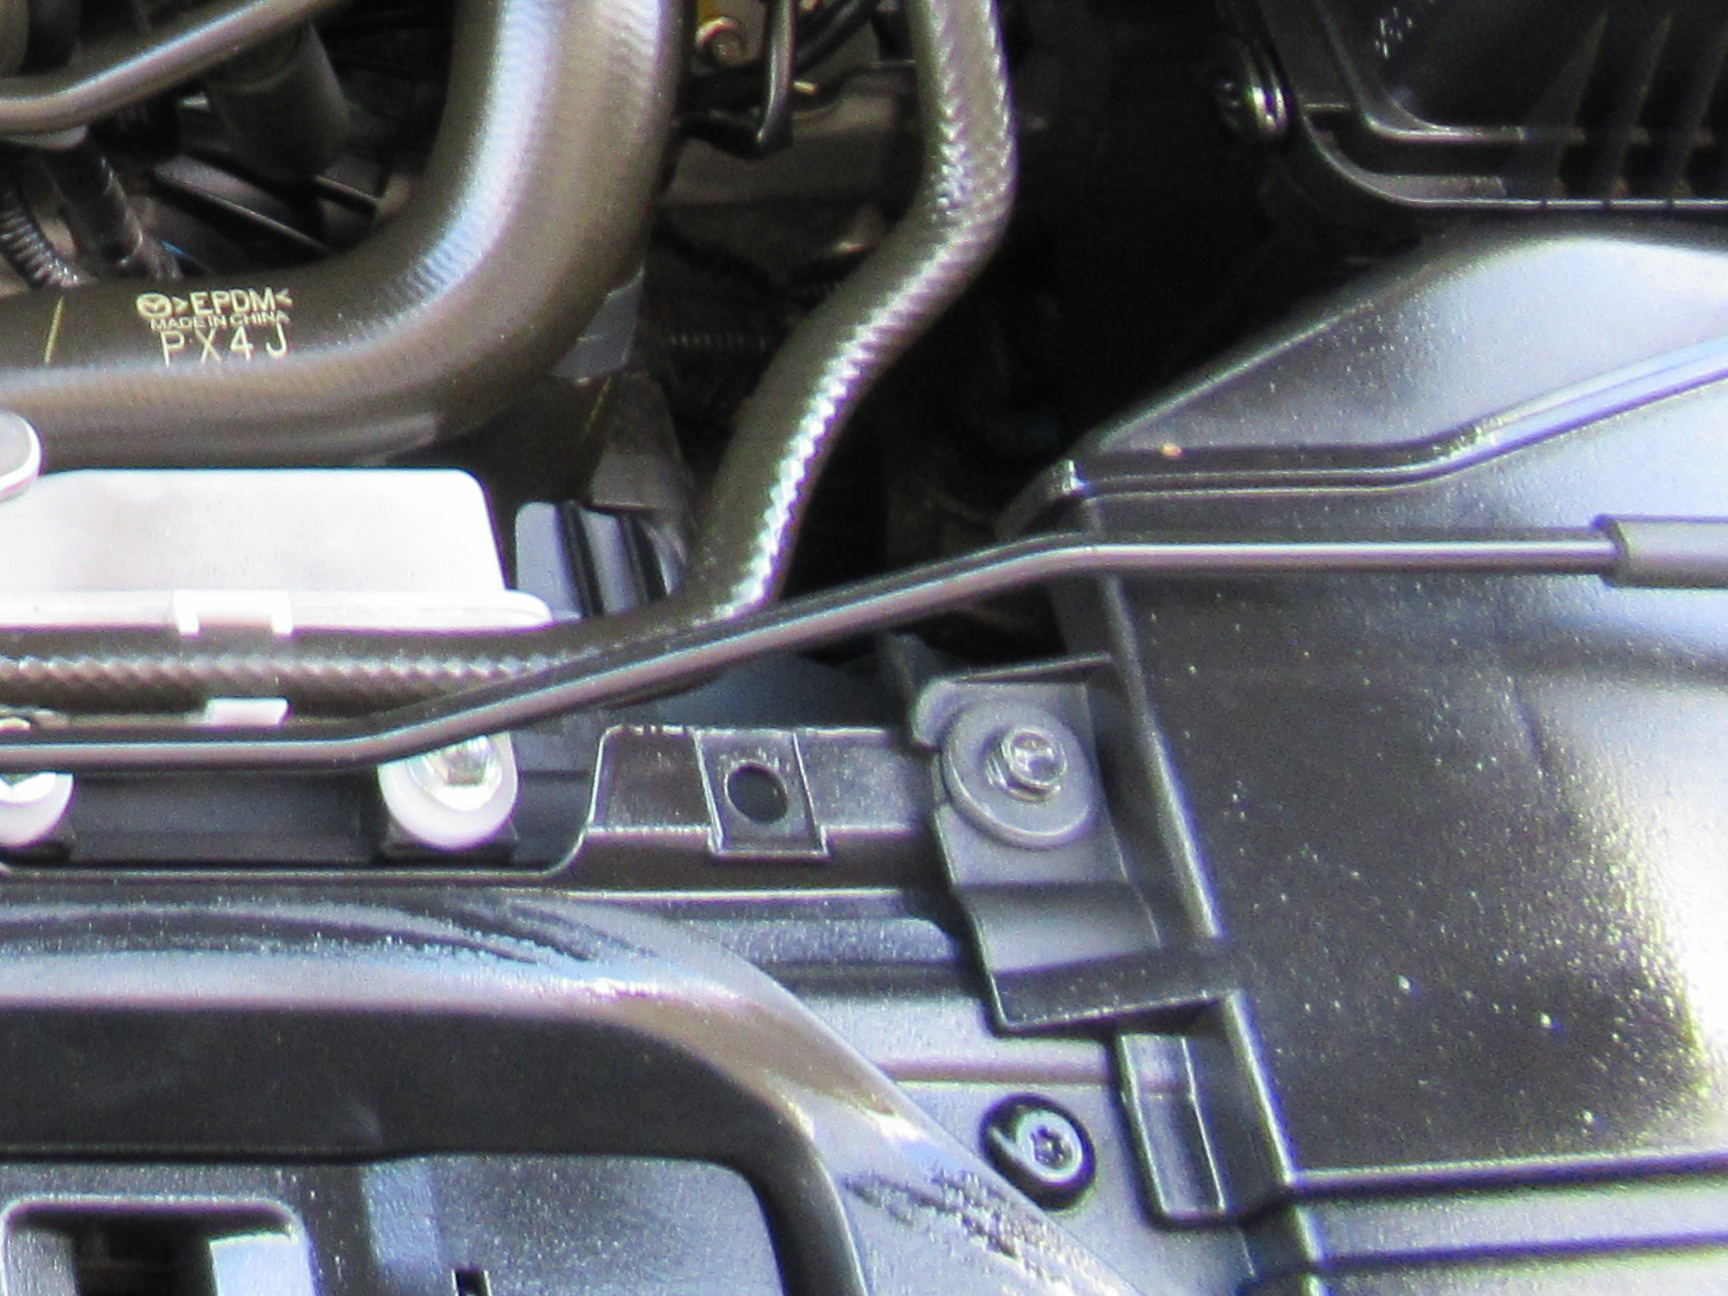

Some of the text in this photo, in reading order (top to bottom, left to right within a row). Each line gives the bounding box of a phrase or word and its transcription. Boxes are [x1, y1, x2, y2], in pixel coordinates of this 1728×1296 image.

[150, 309, 291, 332] MADE IN CHINA
[160, 322, 288, 368] PX4J
